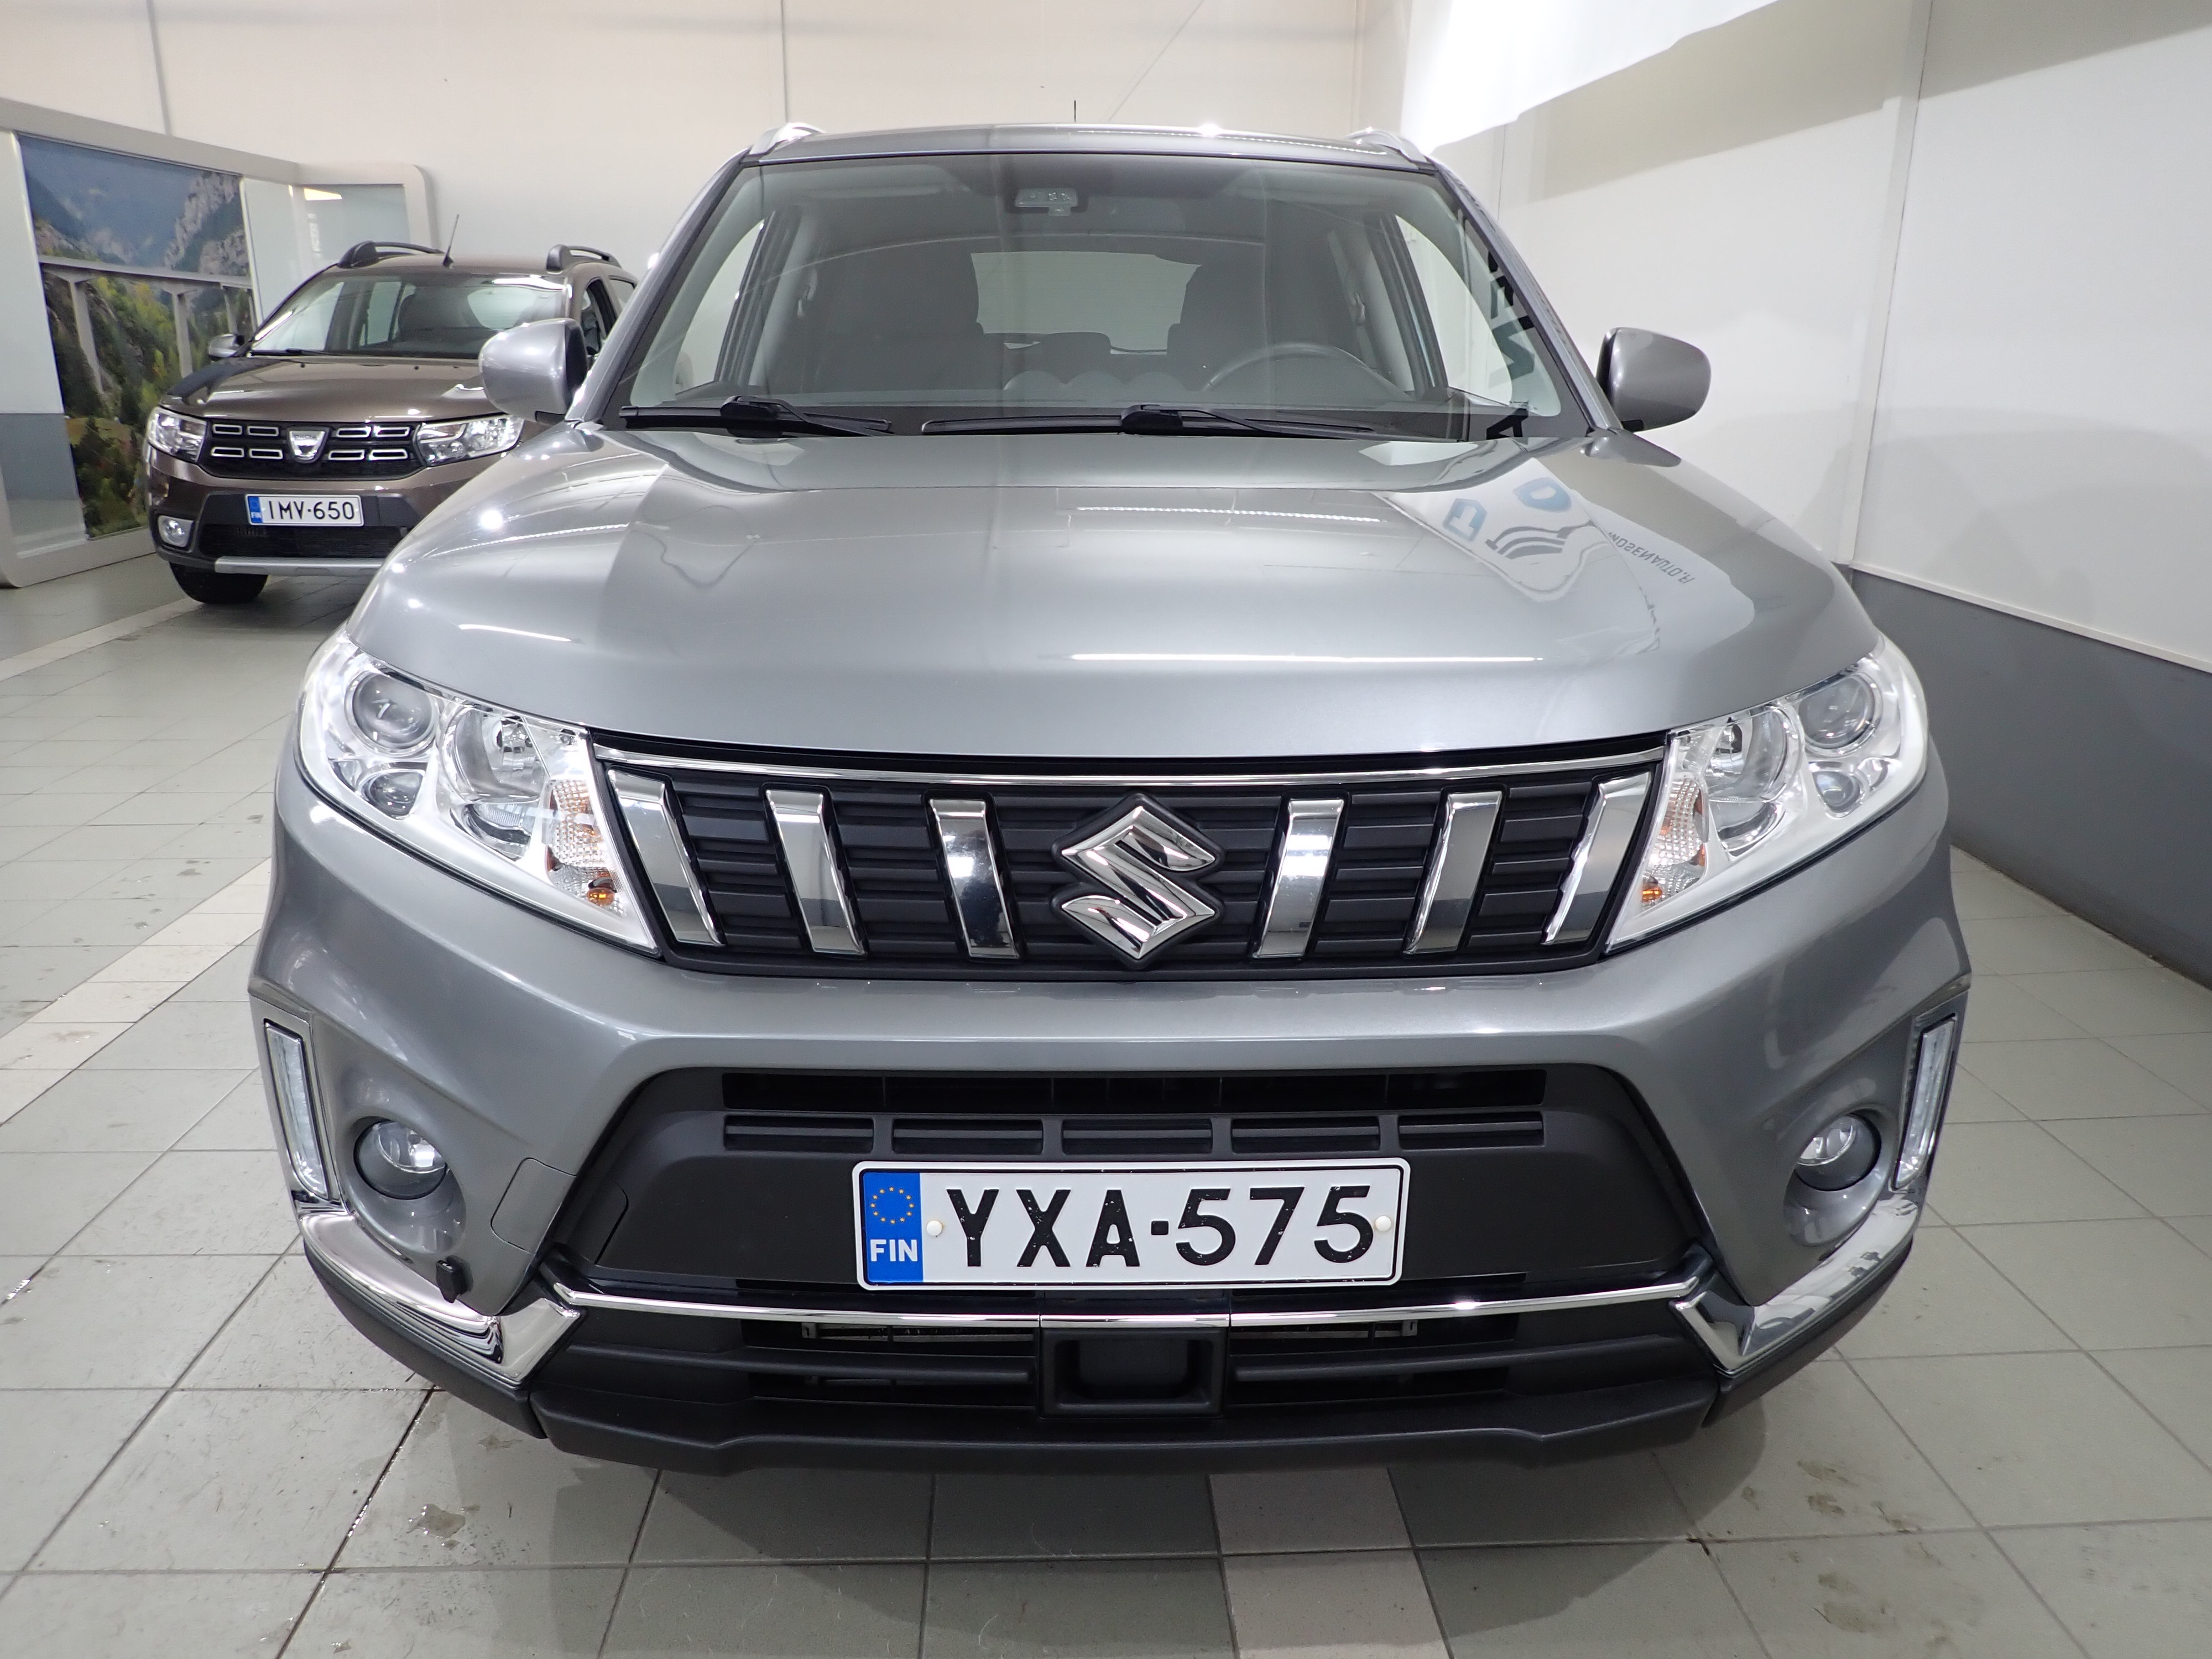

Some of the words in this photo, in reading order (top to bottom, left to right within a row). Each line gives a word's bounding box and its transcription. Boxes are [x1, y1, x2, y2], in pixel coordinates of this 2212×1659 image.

[269, 500, 354, 520] IMV-650
[870, 1239, 919, 1262] FIN
[946, 1186, 1375, 1267] YXA-575
